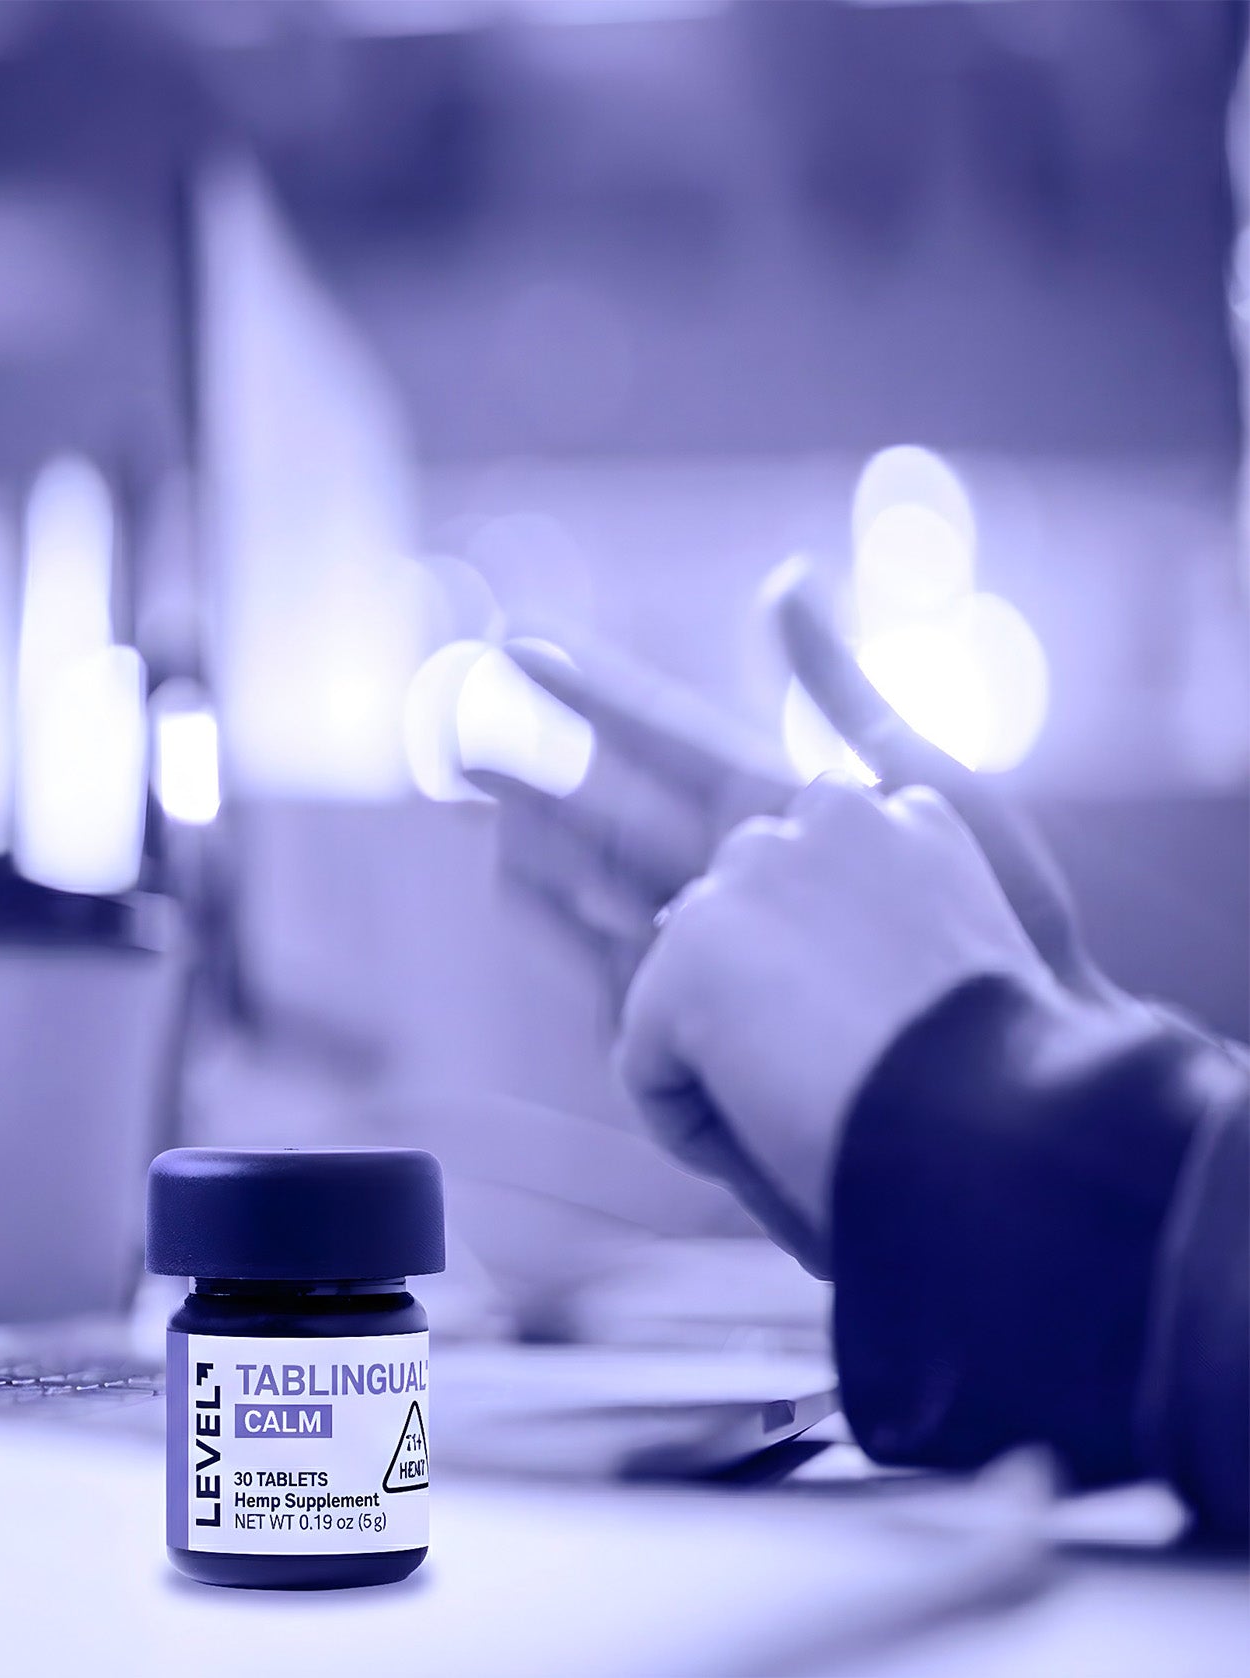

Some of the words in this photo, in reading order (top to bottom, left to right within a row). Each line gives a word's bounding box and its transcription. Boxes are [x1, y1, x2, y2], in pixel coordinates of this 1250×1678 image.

[236, 1361, 427, 1396] TABLINGUAL
[244, 1410, 321, 1432] CALM
[196, 1385, 221, 1527] LEVEL
[234, 1472, 252, 1487] 30
[257, 1472, 328, 1487] TABLETS
[235, 1492, 280, 1512] Hemp
[285, 1492, 380, 1512] Supplement
[235, 1514, 265, 1530] NET
[269, 1514, 295, 1530] WT
[299, 1514, 332, 1530] 0.19
[336, 1517, 354, 1530] oz
